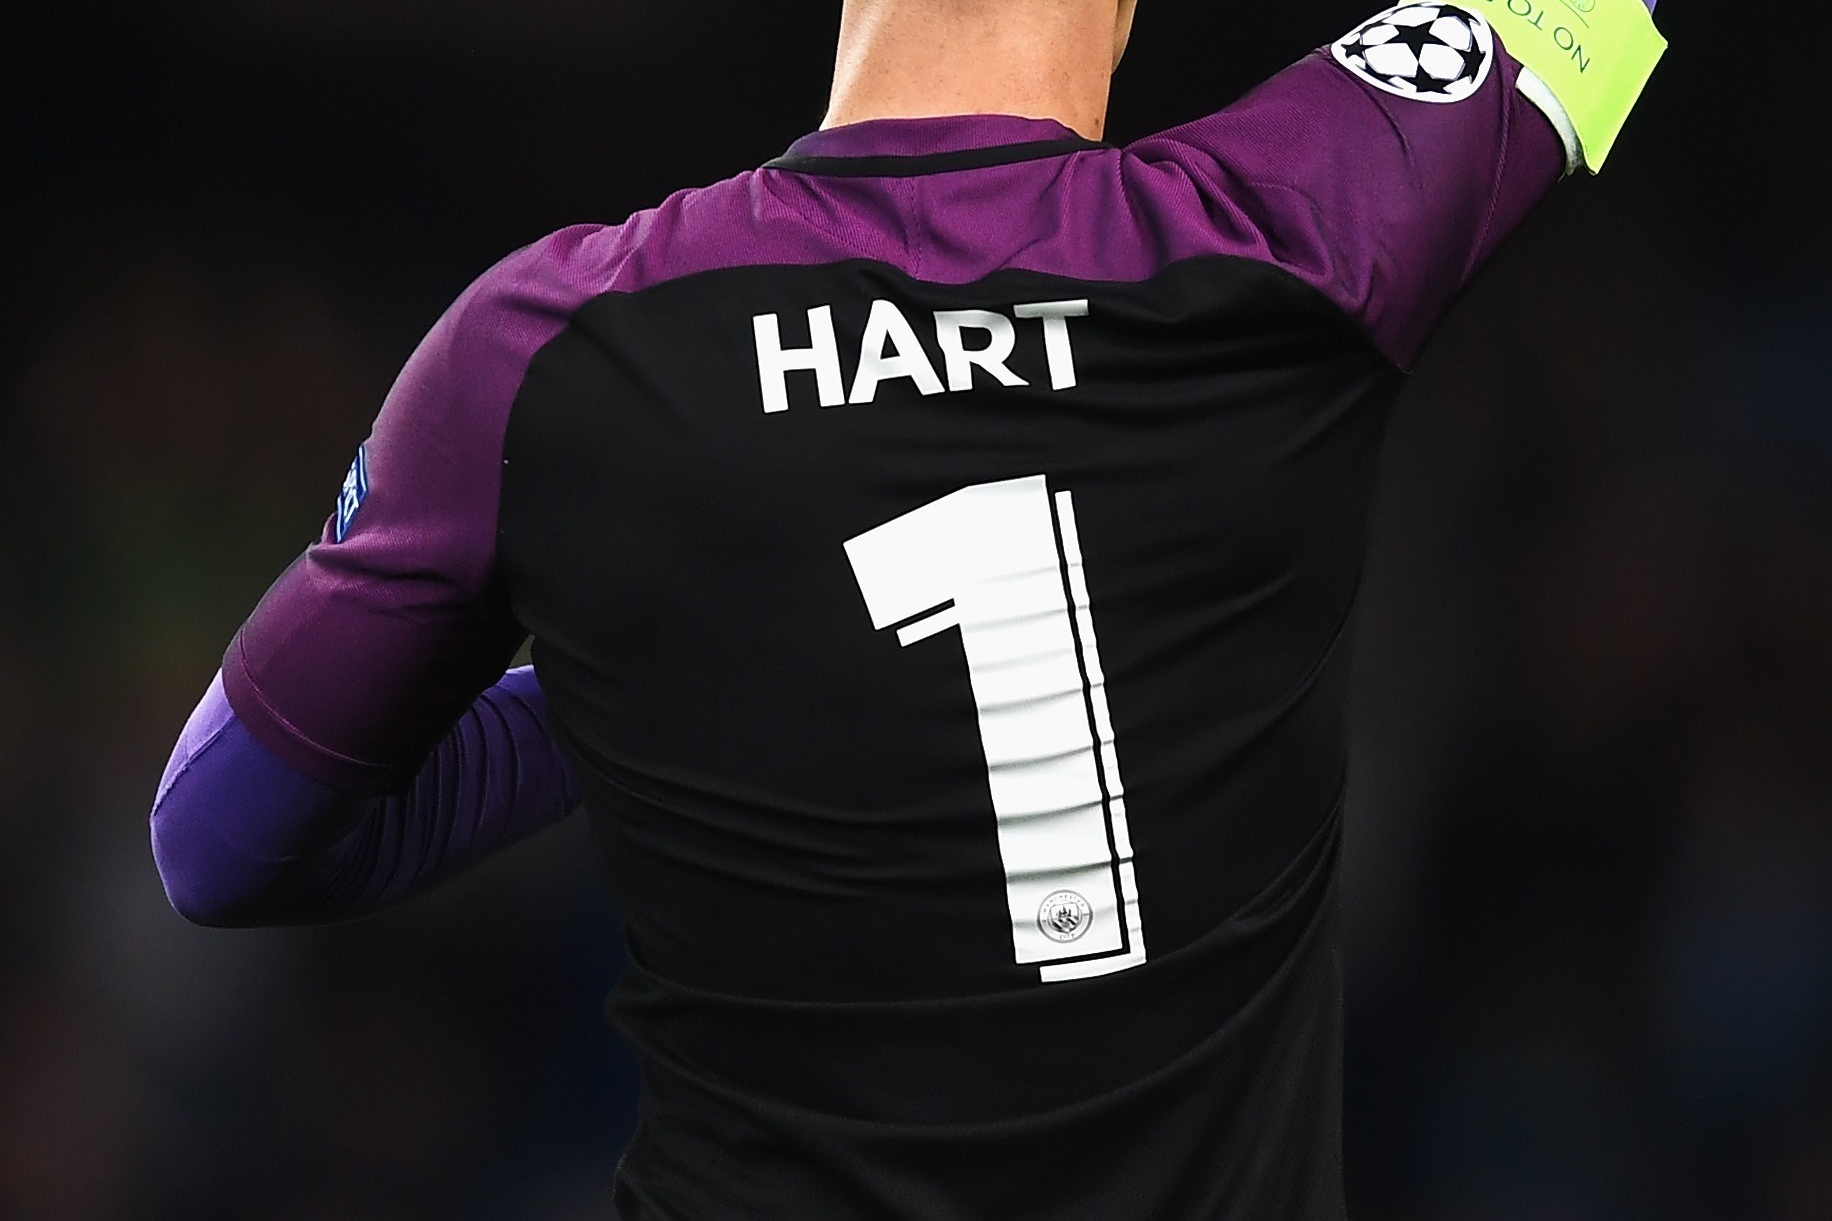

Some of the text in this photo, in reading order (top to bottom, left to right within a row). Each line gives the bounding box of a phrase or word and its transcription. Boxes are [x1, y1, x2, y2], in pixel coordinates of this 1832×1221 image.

[1553, 26, 1591, 74] NO
[752, 299, 1090, 414] HART
[843, 474, 1147, 984] 1
